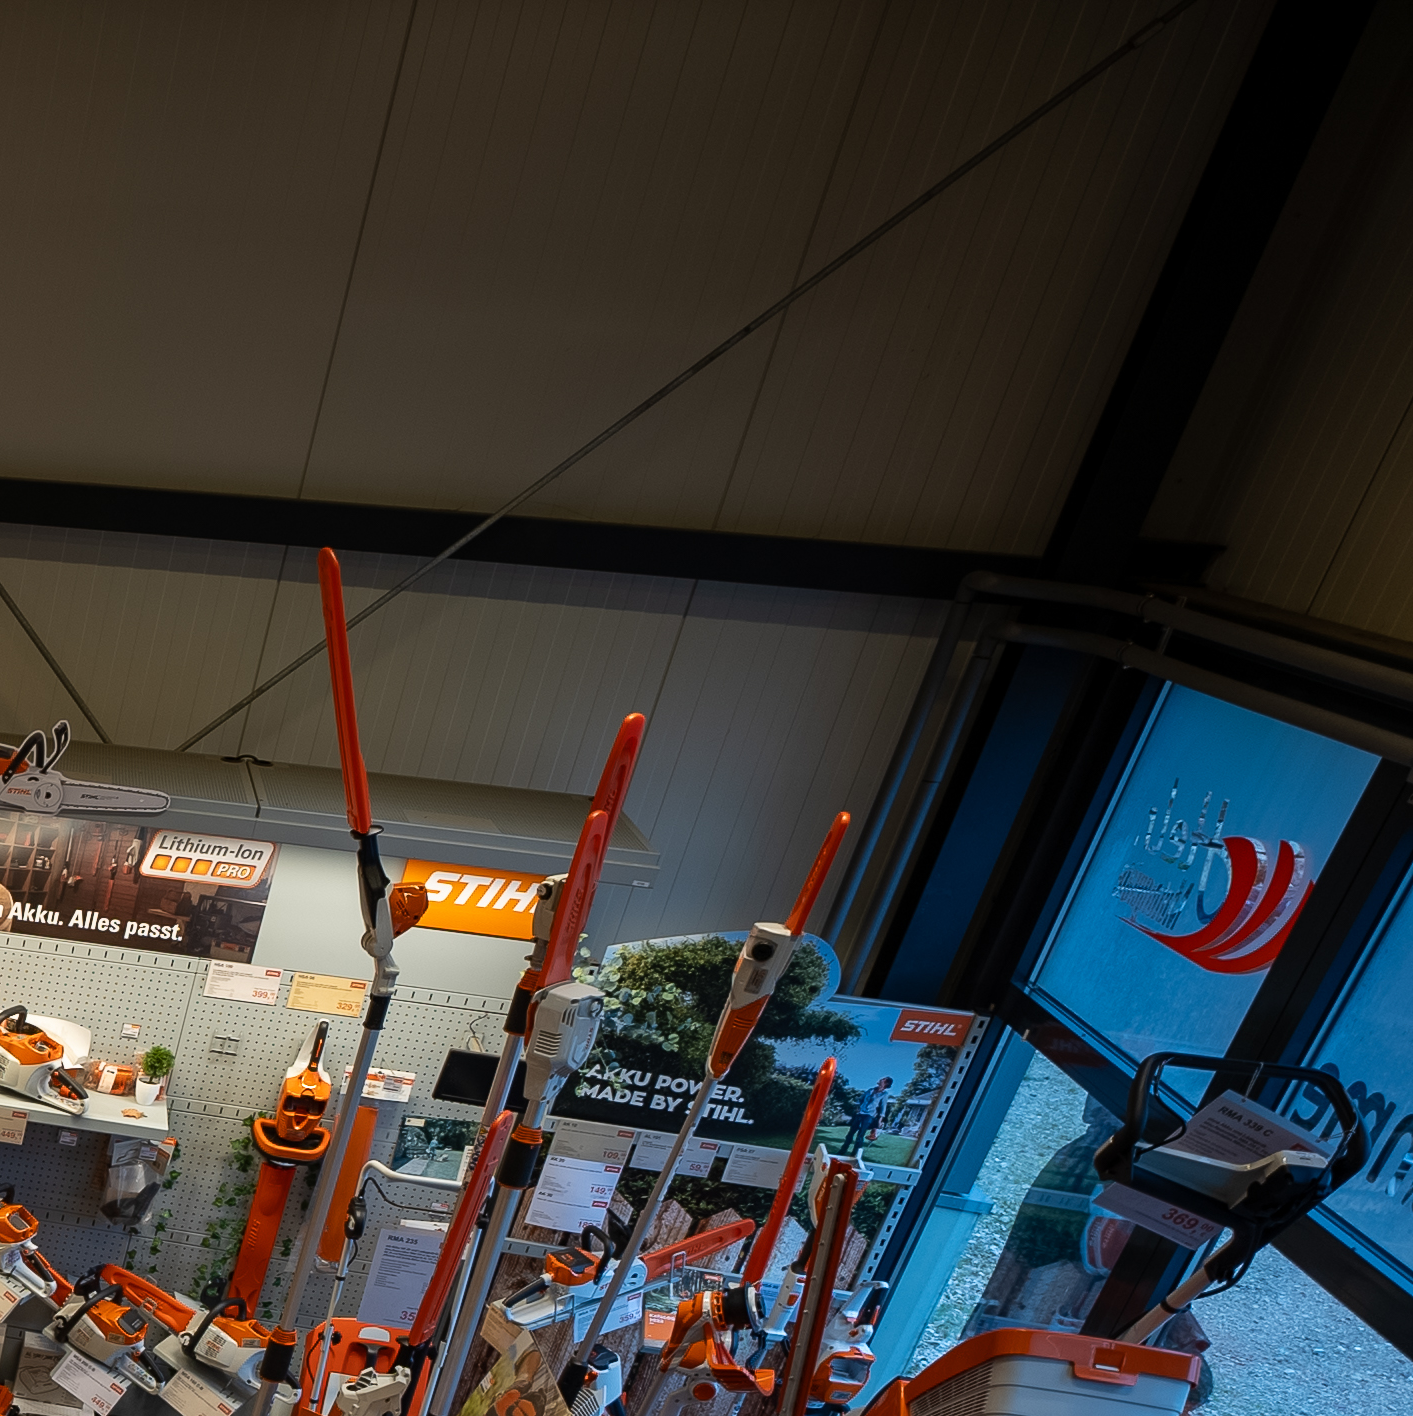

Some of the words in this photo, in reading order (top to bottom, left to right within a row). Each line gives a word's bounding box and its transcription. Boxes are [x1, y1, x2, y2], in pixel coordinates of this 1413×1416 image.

[7, 787, 32, 797] STIHL
[158, 835, 264, 861] Lithium-Ion
[215, 865, 252, 879] PRO
[425, 871, 540, 915] STIH
[7, 901, 64, 927] Akku.
[68, 909, 121, 933] Alles
[124, 921, 184, 942] passt.
[900, 1019, 957, 1037] STIHL
[585, 1063, 652, 1087] AKKU
[581, 1082, 648, 1106] MADE
[650, 1094, 684, 1113] BY
[1217, 1104, 1245, 1126] RMA
